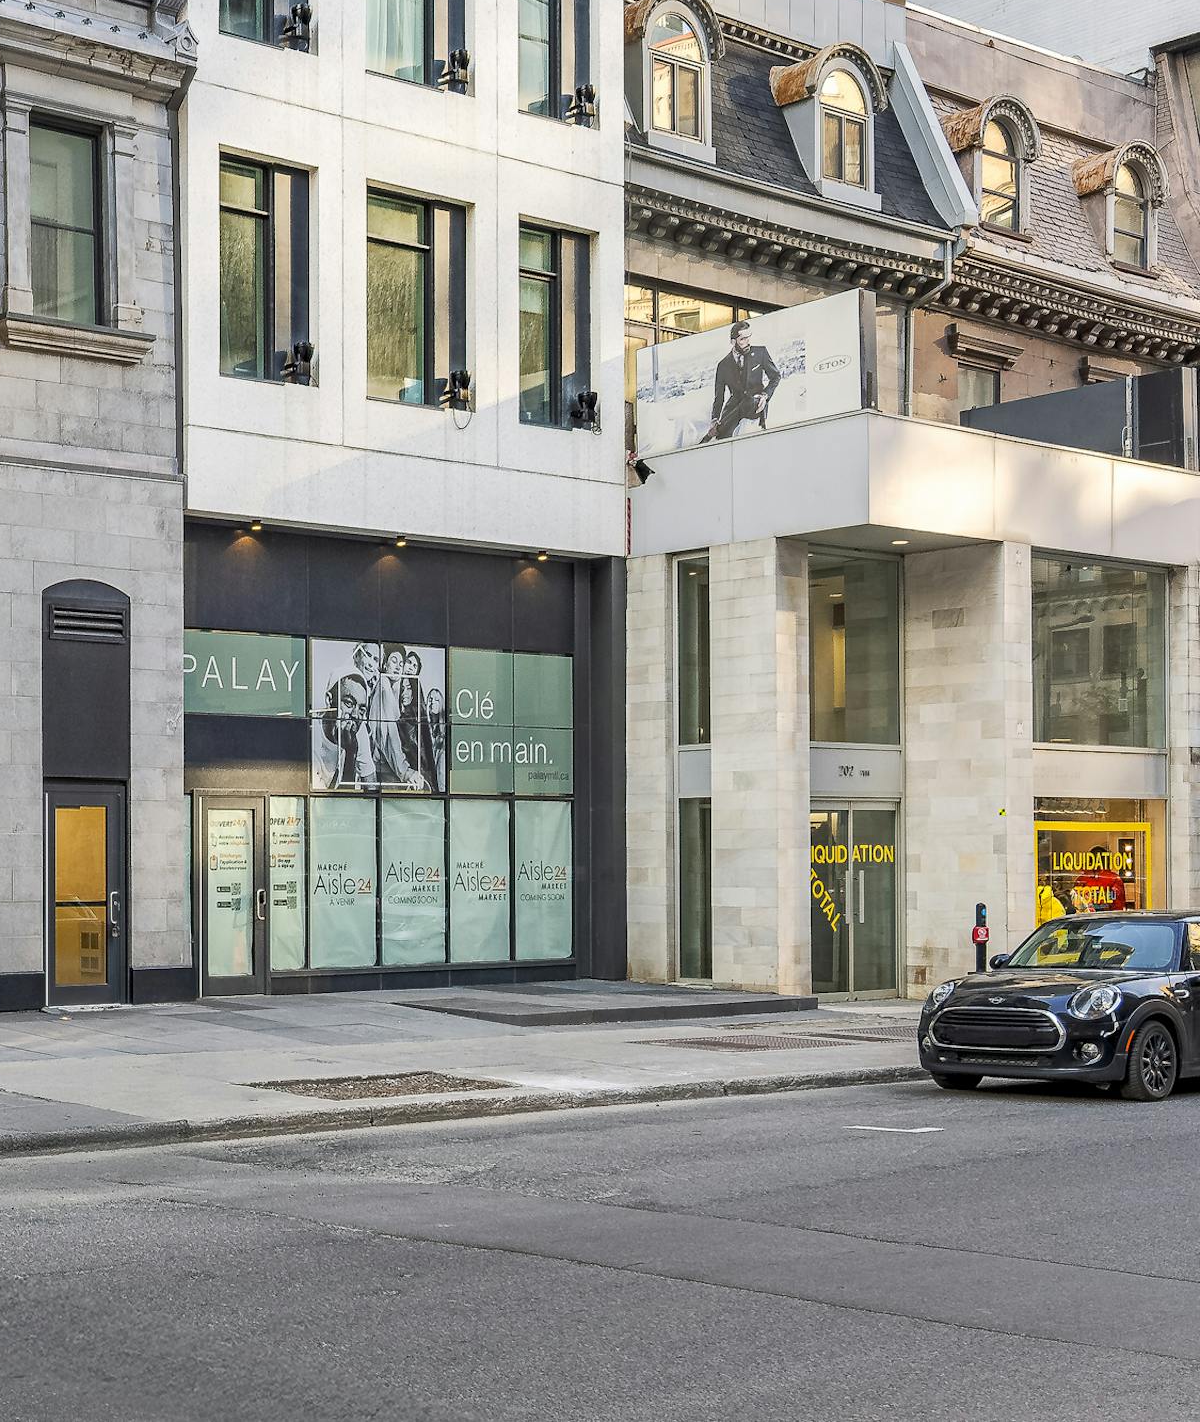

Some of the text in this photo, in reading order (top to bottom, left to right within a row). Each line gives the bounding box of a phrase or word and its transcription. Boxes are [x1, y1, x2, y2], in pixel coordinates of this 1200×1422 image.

[818, 357, 847, 371] ETON
[183, 653, 300, 693] PALAY
[456, 688, 494, 720] Clé
[456, 736, 553, 765] en main.
[270, 817, 286, 826] OPEN
[811, 844, 895, 864] IQUIDATION
[1053, 852, 1132, 871] LIQUIDATION
[317, 861, 348, 871] MARCHÉ
[541, 882, 567, 890] MARKET
[1074, 886, 1113, 904] TOTAL
[478, 893, 506, 901] MARKET
[810, 867, 841, 932] TOTAL
